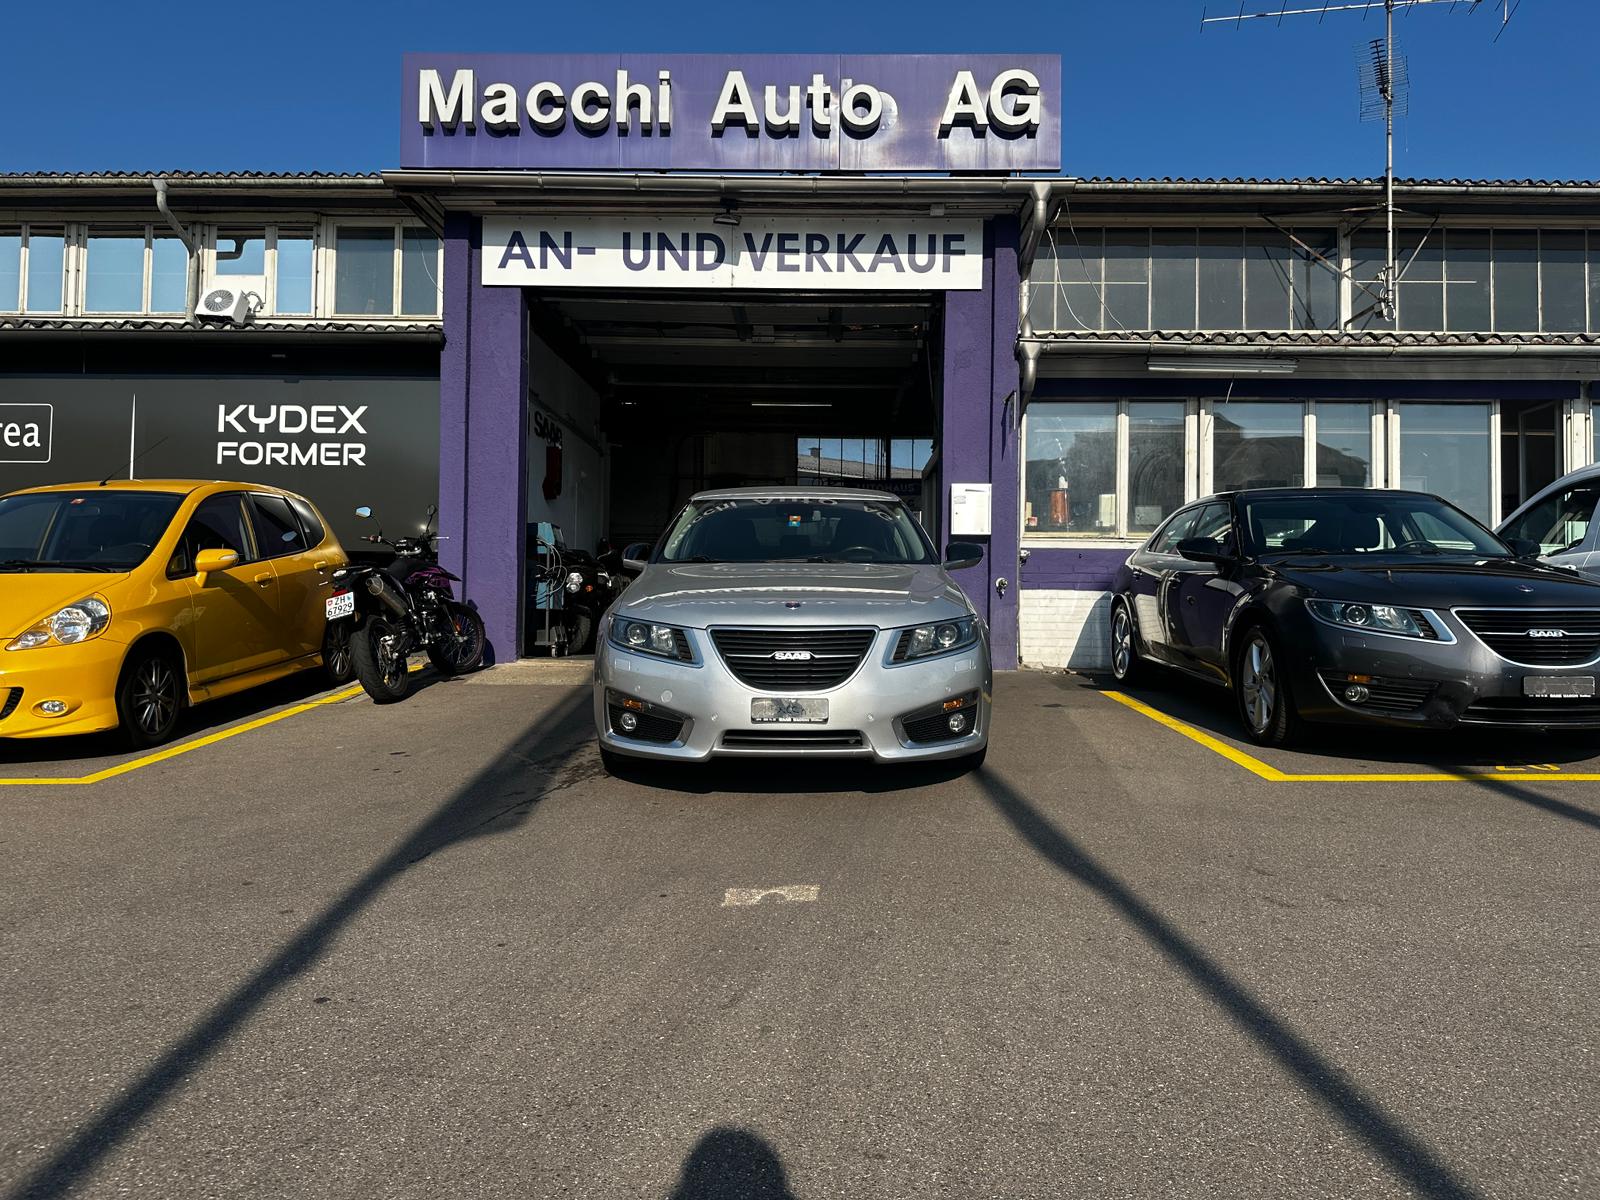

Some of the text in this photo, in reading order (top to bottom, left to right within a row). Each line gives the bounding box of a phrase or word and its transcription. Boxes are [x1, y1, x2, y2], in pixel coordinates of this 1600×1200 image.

[418, 69, 1041, 132] Macchi Auto AG
[497, 230, 966, 273] AN- UND VERKAUF
[217, 404, 369, 434] KYDEX
[216, 441, 367, 466] FORMER
[328, 602, 352, 616] 67929
[335, 596, 346, 605] ZH
[1529, 629, 1563, 637] SAAB
[774, 651, 811, 660] SAAB
